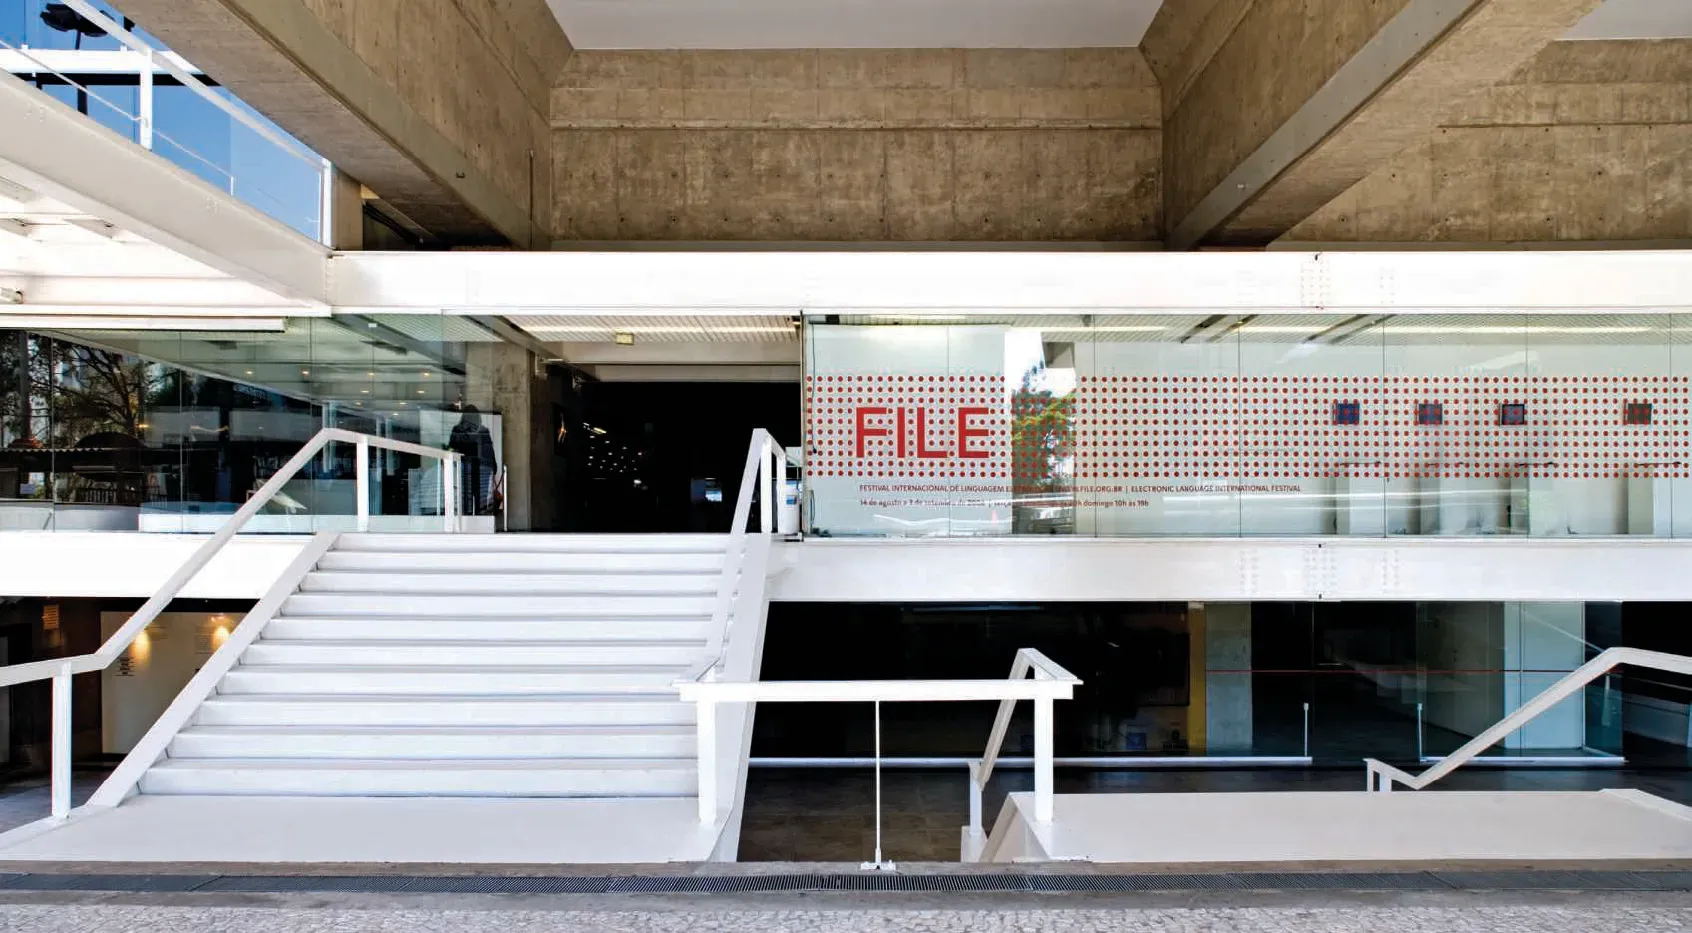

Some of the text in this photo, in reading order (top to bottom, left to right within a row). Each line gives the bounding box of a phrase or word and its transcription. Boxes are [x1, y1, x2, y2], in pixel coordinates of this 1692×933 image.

[856, 406, 990, 459] FILE
[860, 484, 890, 493] FESTIVAL
[891, 484, 948, 493] INTERNACIONAL
[949, 485, 960, 493] DE
[961, 485, 1005, 493] LINGUAGEM
[1131, 485, 1174, 493] ELECTRONIC
[1176, 485, 1214, 493] LANGUAGE
[1215, 484, 1269, 493] INTERNATIONAL
[1271, 484, 1301, 493] FESTIVAL
[1083, 499, 1114, 509] domingo
